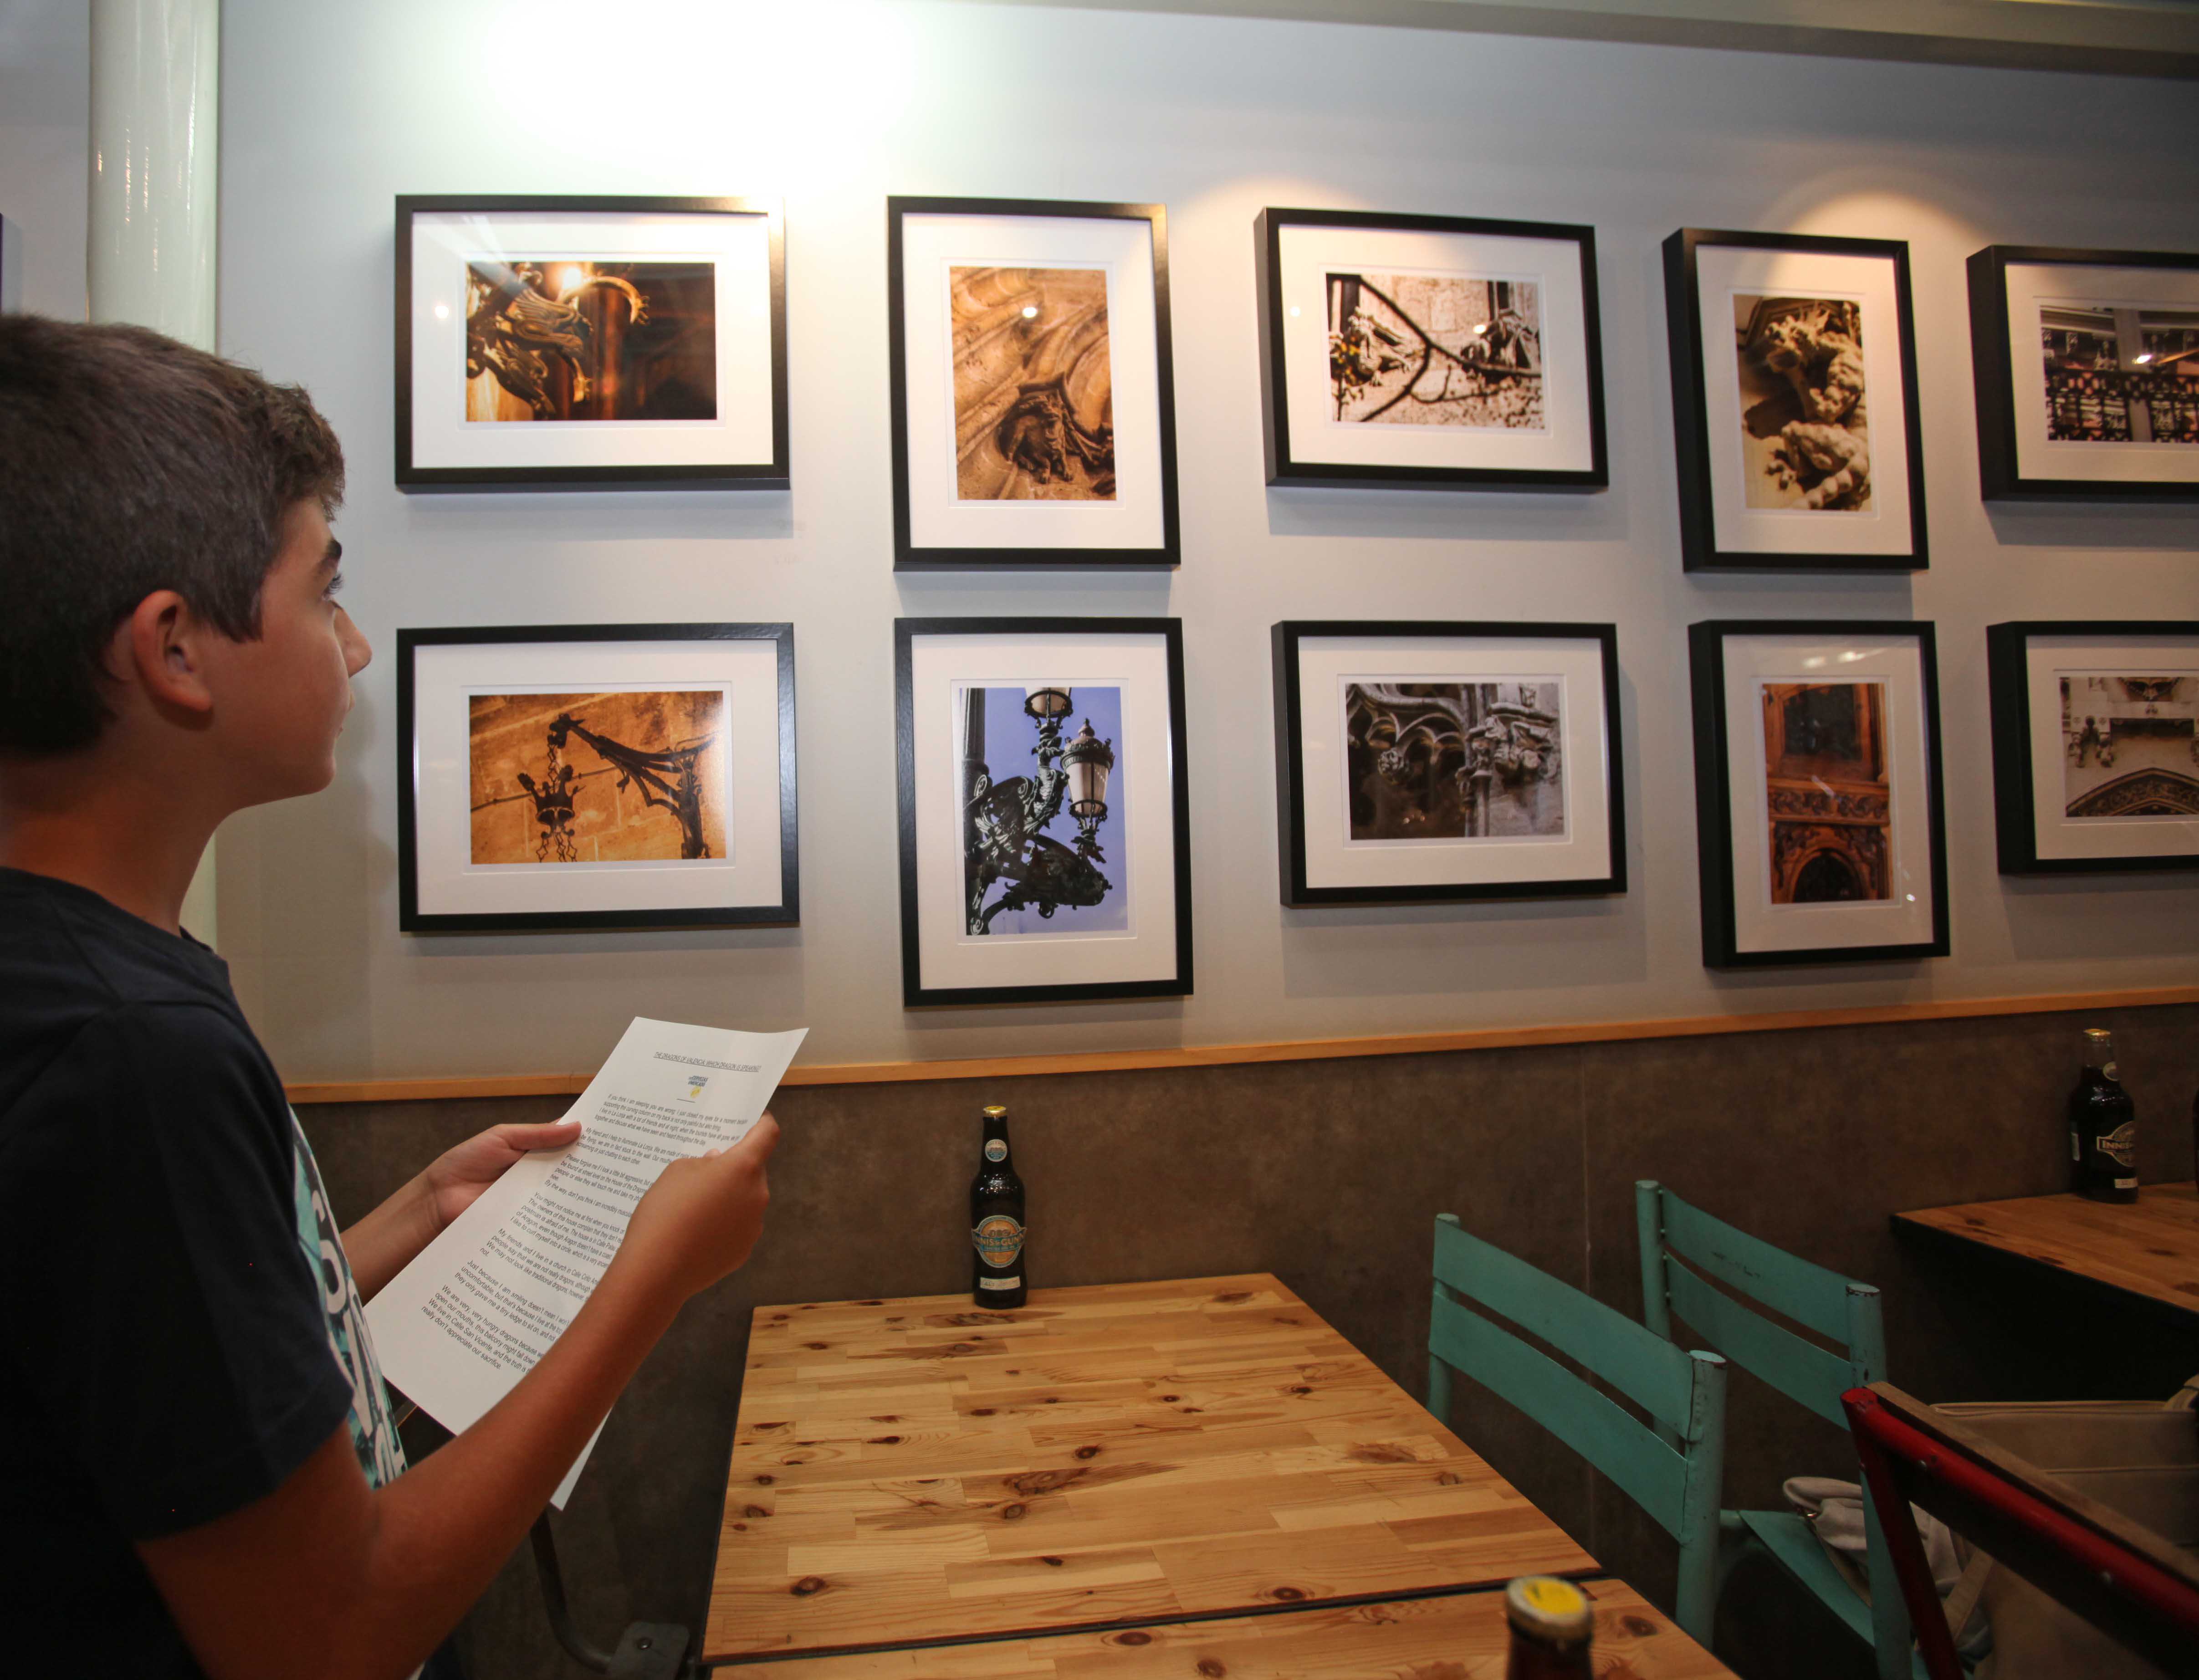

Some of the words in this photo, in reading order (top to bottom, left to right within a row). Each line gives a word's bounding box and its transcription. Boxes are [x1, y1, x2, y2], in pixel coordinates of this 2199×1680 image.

[442, 1285, 451, 1295] We
[450, 1293, 460, 1302] are
[460, 1301, 471, 1313] very,
[472, 1310, 483, 1321] very
[482, 1318, 500, 1333] hungry
[500, 1330, 519, 1344] dragons
[518, 1341, 537, 1355] because
[455, 1272, 466, 1284] they
[465, 1282, 476, 1292] only
[475, 1290, 488, 1301] gave
[500, 1306, 510, 1316] tiny
[509, 1312, 522, 1324] ledge
[540, 1330, 551, 1339] and
[467, 1260, 479, 1270] Just
[478, 1268, 499, 1286] because
[511, 1292, 527, 1305] smiling
[528, 1302, 544, 1313] doesn't
[544, 1310, 556, 1319] mean
[495, 1291, 504, 1301] but
[503, 1297, 517, 1309] that's
[516, 1305, 535, 1320] because
[537, 1316, 545, 1325] live
[422, 1306, 435, 1319] really
[435, 1317, 449, 1330] don't
[447, 1327, 472, 1349] appreciate
[472, 1347, 481, 1355] our
[481, 1353, 501, 1369] sacrifice.
[429, 1298, 438, 1308] We
[437, 1306, 446, 1316] live
[451, 1317, 464, 1330] Calle
[464, 1327, 474, 1338] San
[475, 1335, 492, 1351] Vicente,
[493, 1350, 505, 1358] and
[503, 1354, 511, 1363] the
[511, 1359, 522, 1369] truth
[435, 1292, 448, 1305] open
[447, 1303, 457, 1311] our
[455, 1310, 474, 1326] mouths,
[475, 1324, 485, 1334] this
[484, 1331, 503, 1347] balcony
[502, 1343, 517, 1355] might
[516, 1351, 525, 1359] fall
[523, 1355, 535, 1365] down
